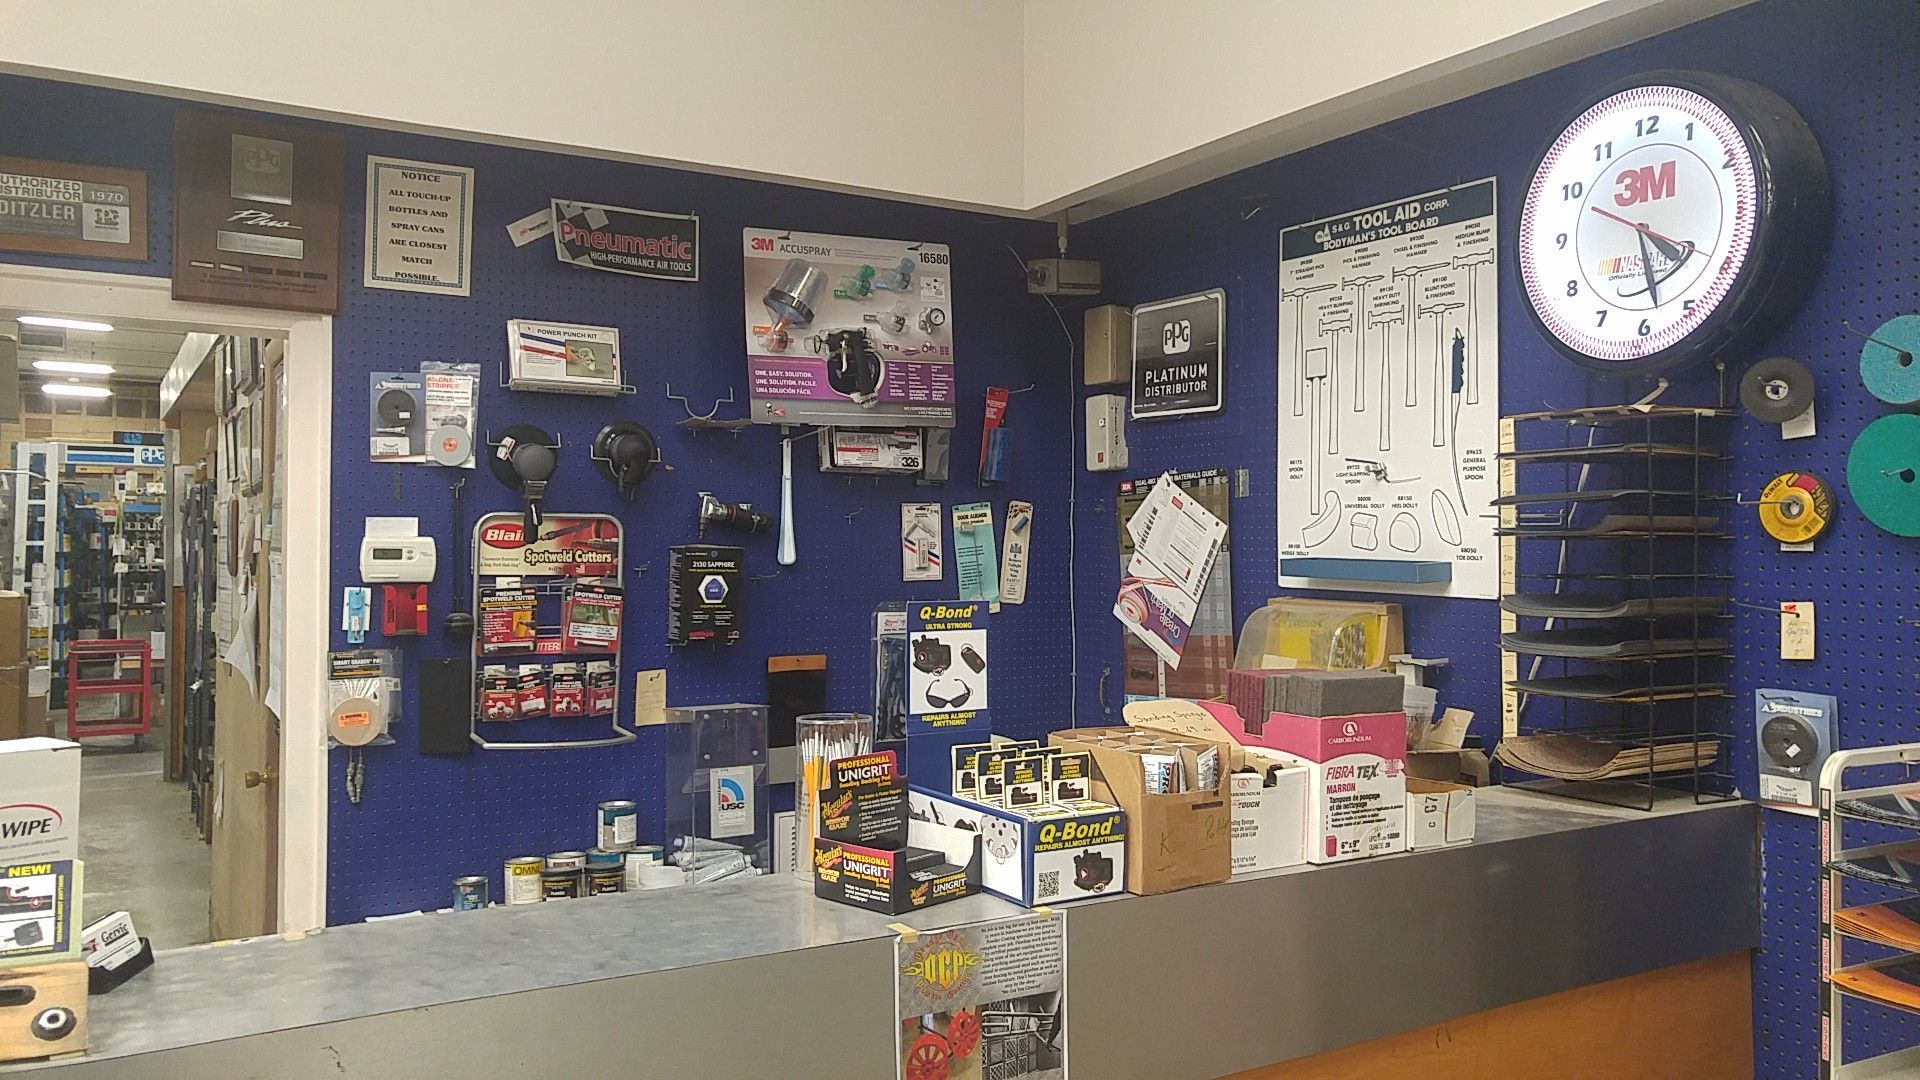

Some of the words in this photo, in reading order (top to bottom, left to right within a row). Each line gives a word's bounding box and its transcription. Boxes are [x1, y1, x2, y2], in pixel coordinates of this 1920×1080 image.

[1635, 115, 1660, 137] 12
[1685, 122, 1695, 141] 1
[1594, 141, 1614, 161] 11
[0, 175, 81, 191] UTHORIZED
[401, 172, 441, 183] NOTICE
[1614, 160, 1677, 207] 3M
[0, 185, 82, 202] ISTRIBUTOR
[88, 190, 124, 202] 1970
[388, 189, 405, 198] ALL
[407, 191, 452, 202] TOUCH-UP
[1562, 181, 1583, 201] 10
[388, 205, 428, 216] BOTTLES
[430, 210, 448, 218] AND
[1353, 210, 1392, 231] TOOL
[1394, 202, 1421, 222] AID
[1424, 199, 1449, 212] CORP.
[391, 222, 420, 232] SPRAY
[421, 225, 445, 234] CANS
[1324, 231, 1377, 250] BODYMAN'S
[1378, 225, 1403, 239] TOOL
[1405, 216, 1439, 231] BOARD
[389, 238, 406, 246] ARE
[408, 240, 448, 250] CLOSEST
[560, 221, 692, 260] Pneumatic
[751, 237, 774, 251] 3M
[779, 243, 832, 257] ACCUSPRAY
[1556, 233, 1568, 250] 9
[401, 255, 433, 265] MATCH
[590, 250, 655, 268] HIGH-PERFORMANCE
[656, 260, 669, 270] AIR
[669, 261, 692, 272] TOOLS
[918, 252, 948, 265] 16580
[395, 271, 440, 282] POSSIBLE.
[1608, 271, 1636, 281] Officially
[1566, 280, 1578, 297] 8
[1595, 310, 1608, 328] 7
[1638, 318, 1651, 337] 6
[537, 328, 562, 337] POWER
[563, 331, 587, 339] PUNCH
[587, 332, 598, 340] KIT
[1164, 321, 1189, 348] PPG
[1145, 363, 1208, 384] PLATINUM
[1145, 380, 1208, 397] DISTRIBUTOR
[902, 457, 919, 468] 326
[525, 549, 573, 565] Spotweld
[574, 551, 612, 563] Cutters
[922, 713, 949, 721] REPAIRS
[950, 711, 976, 720] ALMOST
[1328, 736, 1372, 745] CARBORUNDUM
[838, 755, 890, 771] PROFESSIONAL
[838, 764, 890, 783] UNIGRIT
[1326, 764, 1354, 781] FIBRA
[1326, 782, 1356, 795] MARRON
[721, 802, 745, 811] USC
[1, 817, 53, 839] WIPE
[1034, 841, 1064, 852] REPAIRS
[1064, 838, 1091, 849] ALMOST
[1091, 834, 1125, 845] ANYTHING!
[843, 851, 890, 867] PROFESSIONAL
[8, 864, 52, 877] NEW!
[843, 860, 890, 878] UNIGRIT
[933, 877, 967, 893] UNIGRIT
